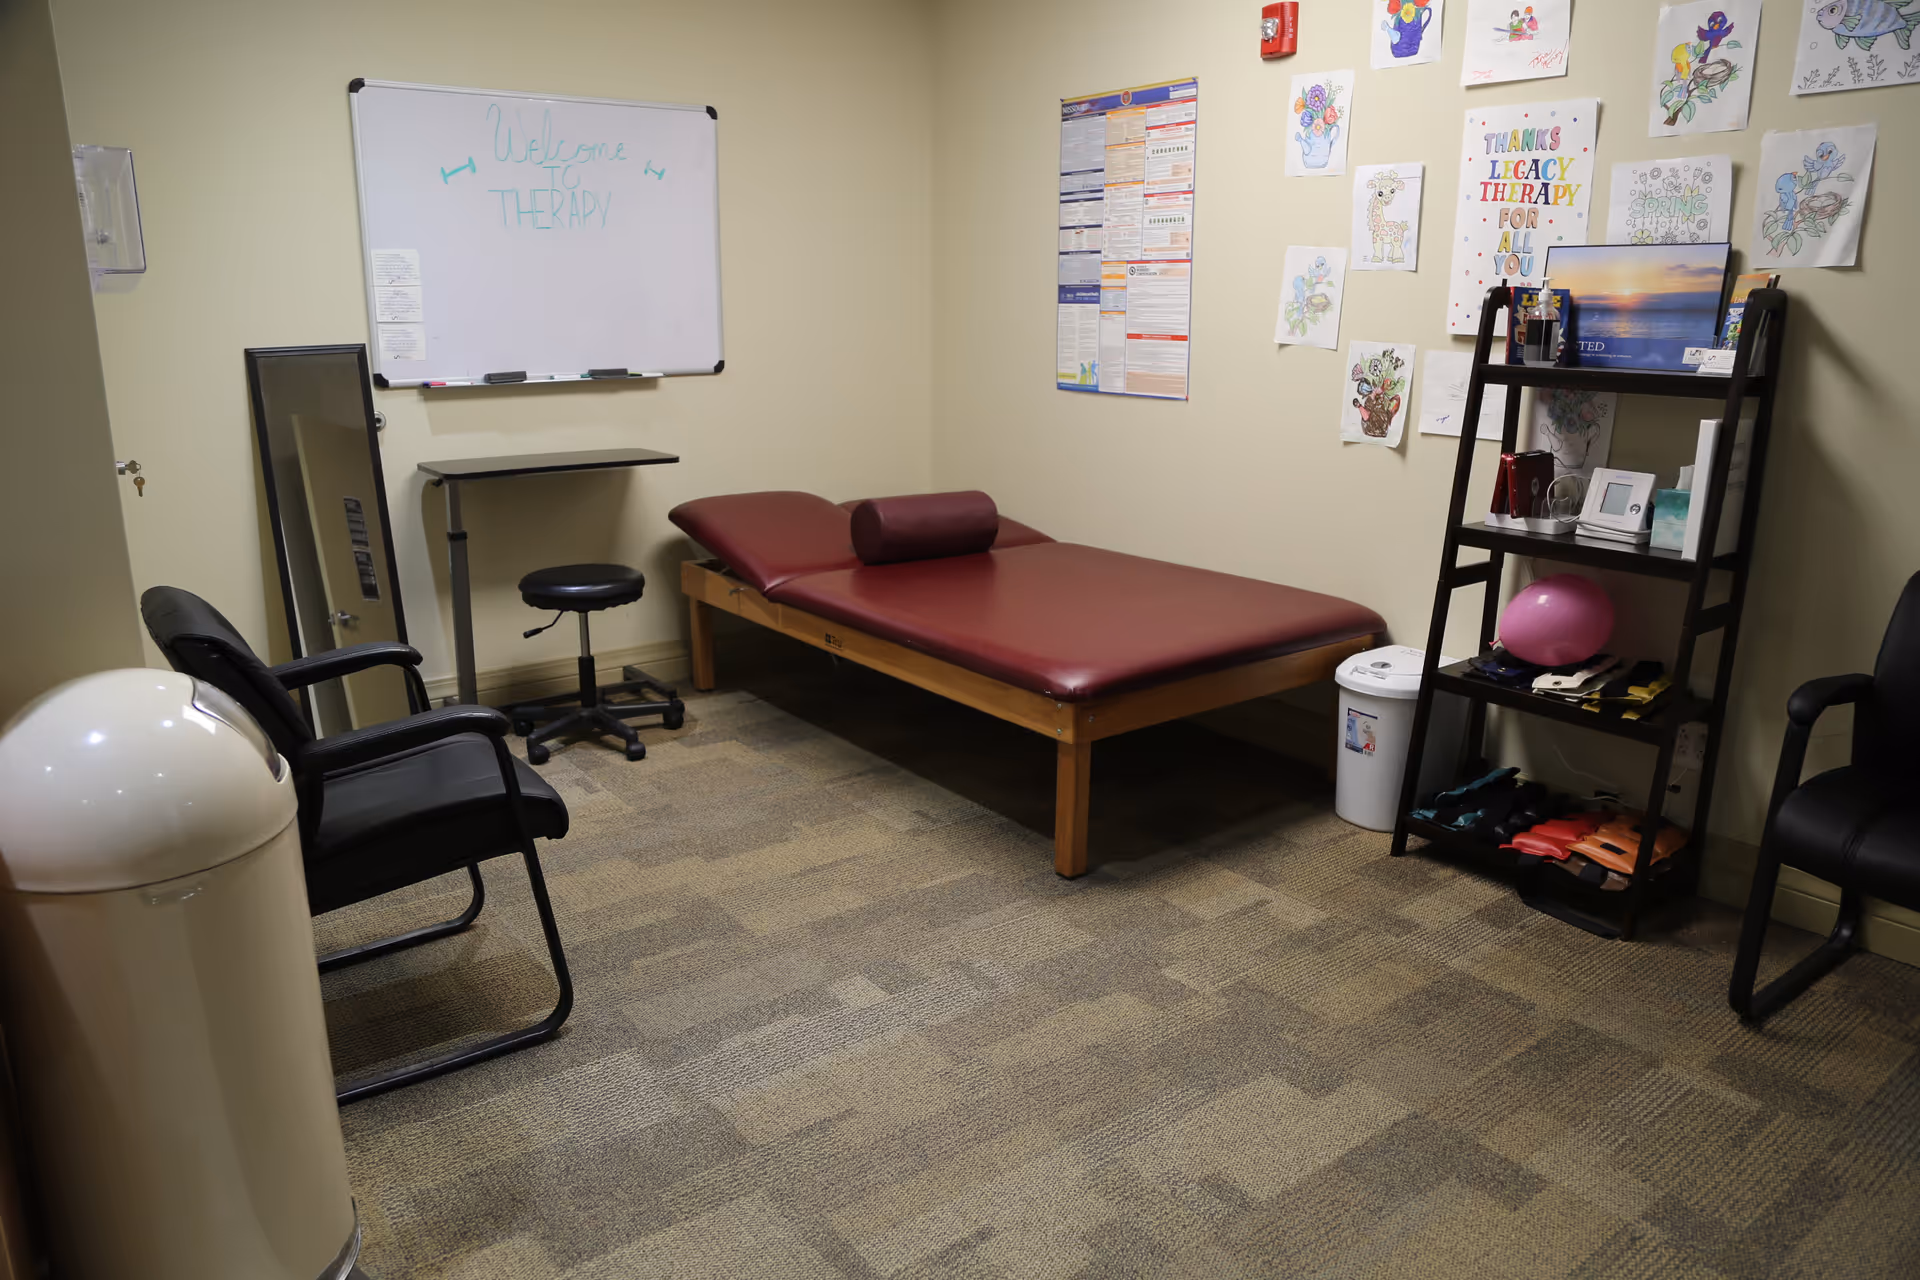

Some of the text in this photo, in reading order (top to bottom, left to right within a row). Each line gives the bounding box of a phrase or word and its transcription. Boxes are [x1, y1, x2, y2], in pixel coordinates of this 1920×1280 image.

[486, 103, 628, 165] Welcome
[1484, 126, 1562, 155] THANKS
[542, 164, 581, 190] TO
[1488, 156, 1576, 182] LEGACY
[1479, 182, 1583, 207] THERAPY
[1629, 194, 1709, 219] SPRING
[487, 187, 612, 229] THERAPY
[1498, 207, 1540, 230] FOR
[1497, 231, 1534, 255] ALL
[1493, 253, 1535, 277] YOU
[1521, 294, 1562, 308] LIE
